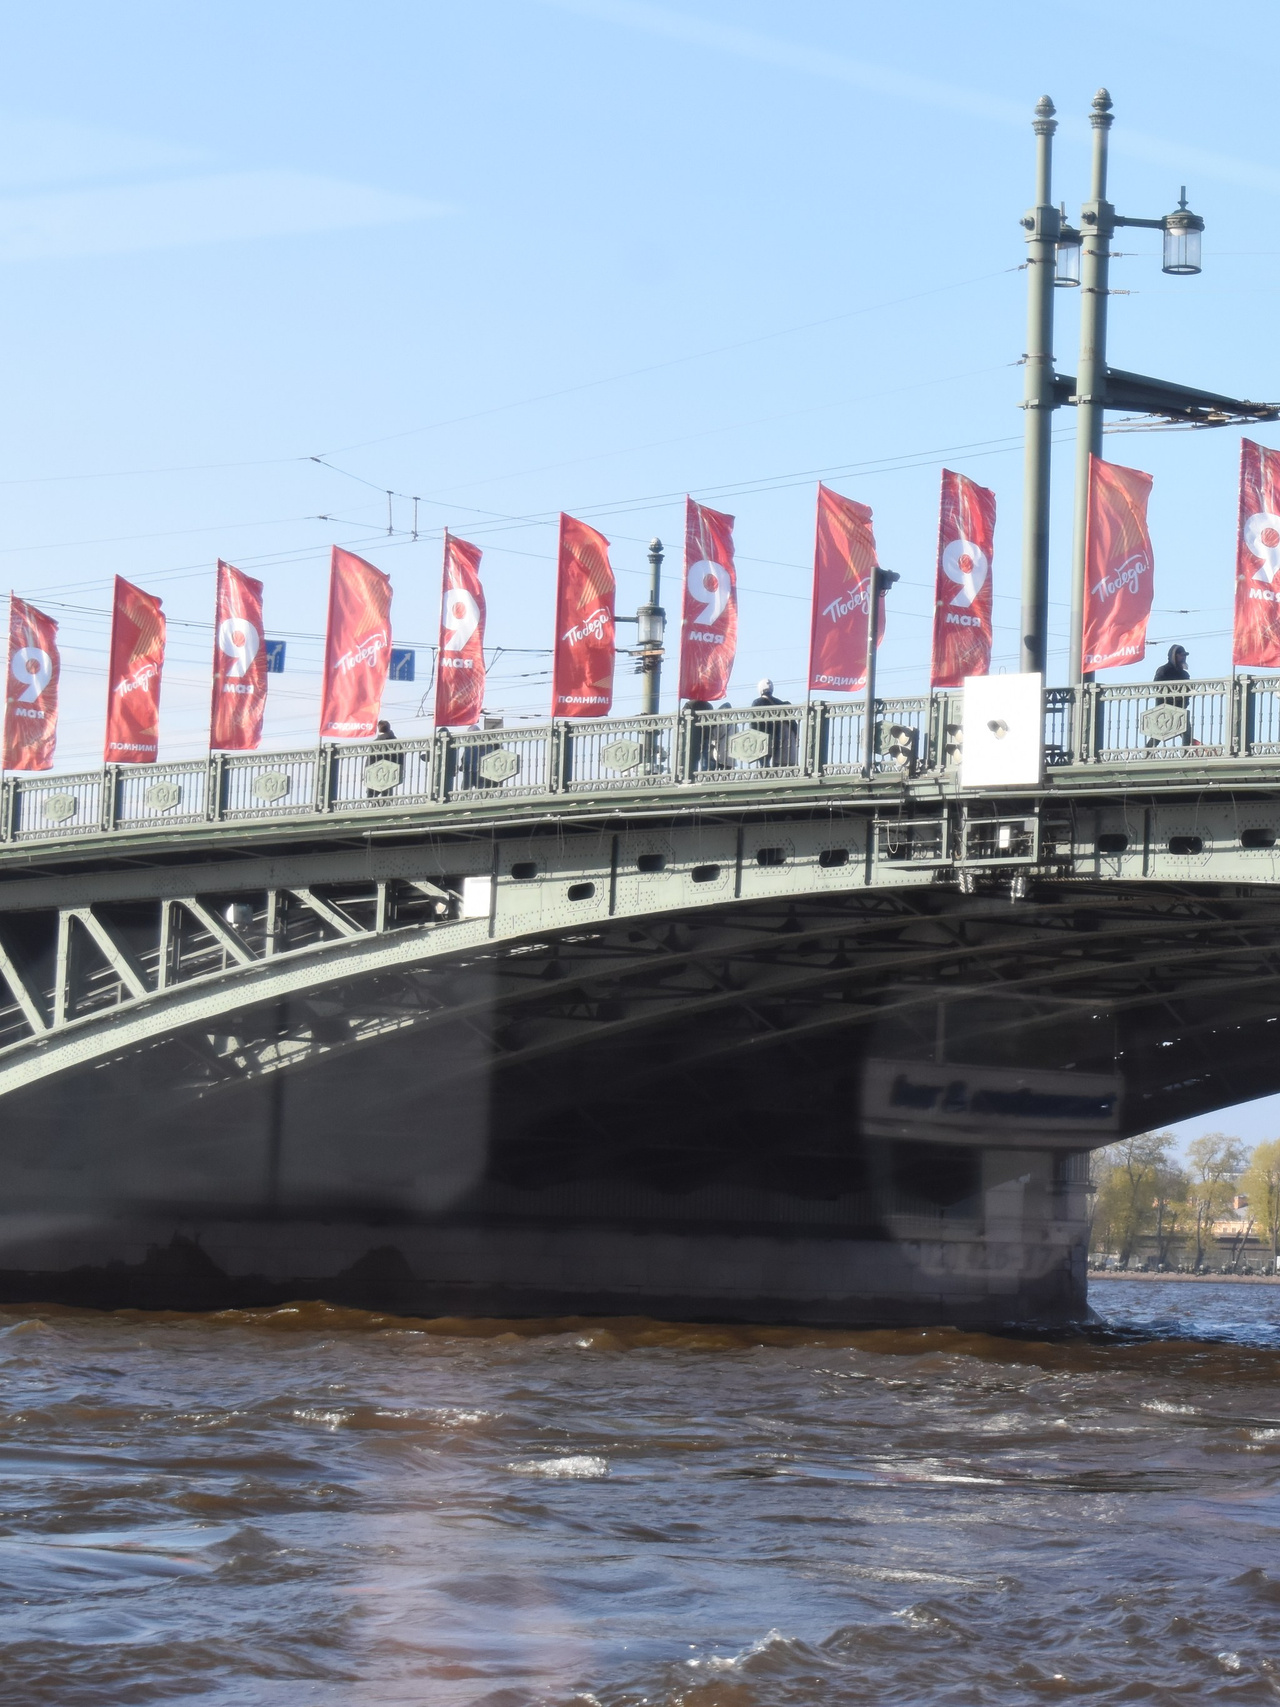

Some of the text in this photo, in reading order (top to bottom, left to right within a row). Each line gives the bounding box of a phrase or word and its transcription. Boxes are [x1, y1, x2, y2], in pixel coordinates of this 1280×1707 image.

[943, 540, 988, 608] 9
[688, 560, 731, 626] 9
[443, 588, 480, 651] 9
[690, 631, 725, 644] мая
[946, 612, 981, 627] мая
[218, 617, 260, 678] 9
[441, 657, 473, 669] мая
[11, 646, 53, 703] 9
[223, 683, 254, 694] мая
[15, 707, 45, 720] мая
